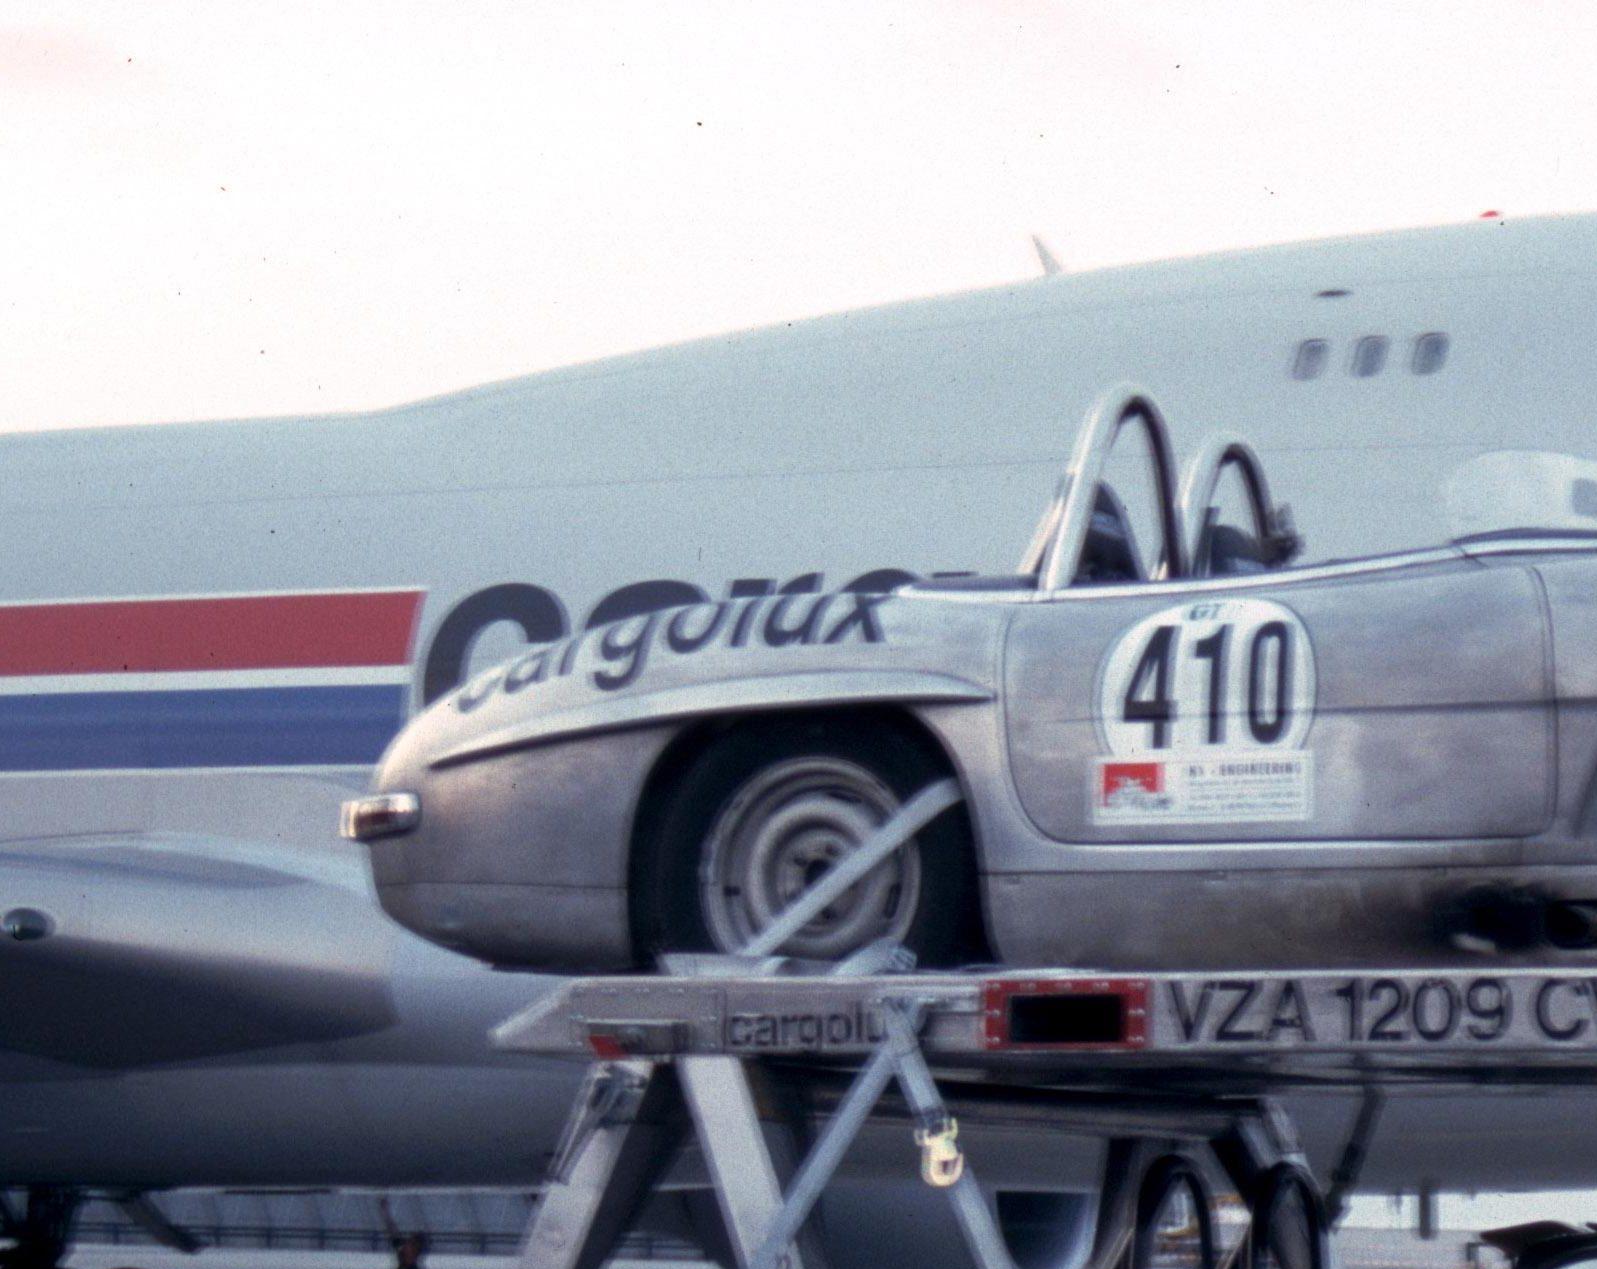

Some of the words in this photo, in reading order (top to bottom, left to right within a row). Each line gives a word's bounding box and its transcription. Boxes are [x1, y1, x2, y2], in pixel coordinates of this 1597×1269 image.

[1123, 620, 1293, 749] 410
[1168, 979, 1316, 1042] VZA
[1335, 977, 1512, 1042] 1209
